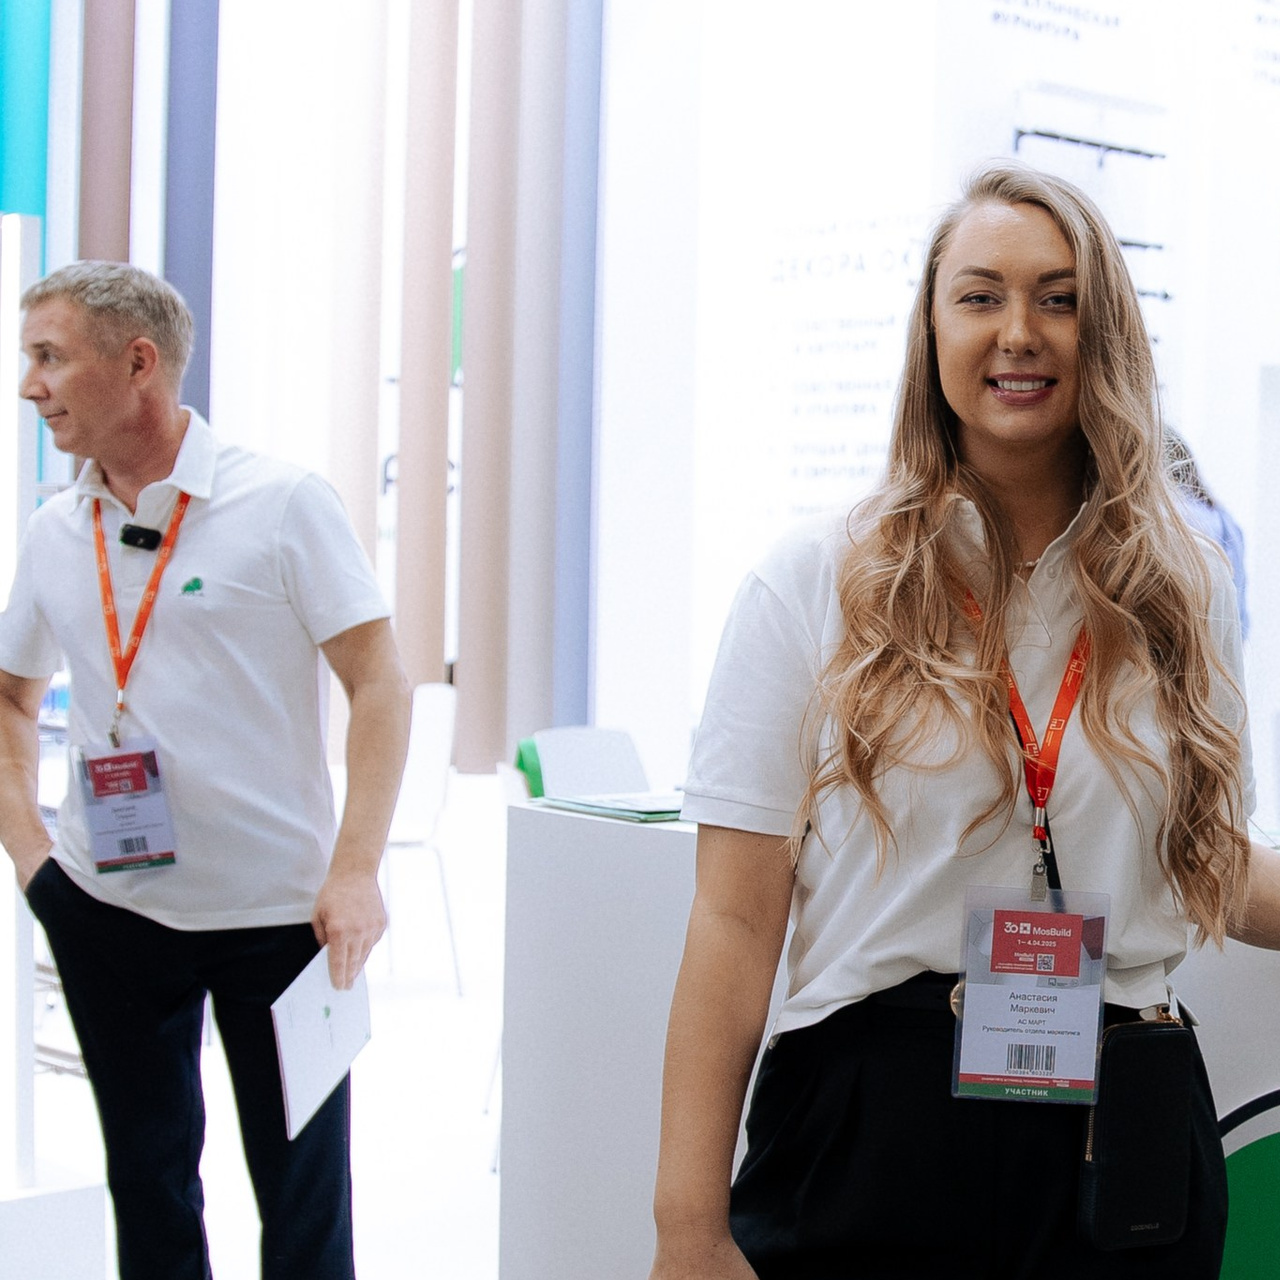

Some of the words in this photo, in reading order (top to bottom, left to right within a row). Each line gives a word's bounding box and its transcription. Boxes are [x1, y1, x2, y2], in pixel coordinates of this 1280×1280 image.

[1033, 926, 1072, 938] MosBuild
[1009, 991, 1058, 1002] Анастасия
[1010, 1004, 1056, 1014] Маркевич
[982, 1025, 1023, 1034] Руководитель
[1047, 1029, 1081, 1037] маркетинга
[1005, 1087, 1049, 1097] УЧАСТНИК
